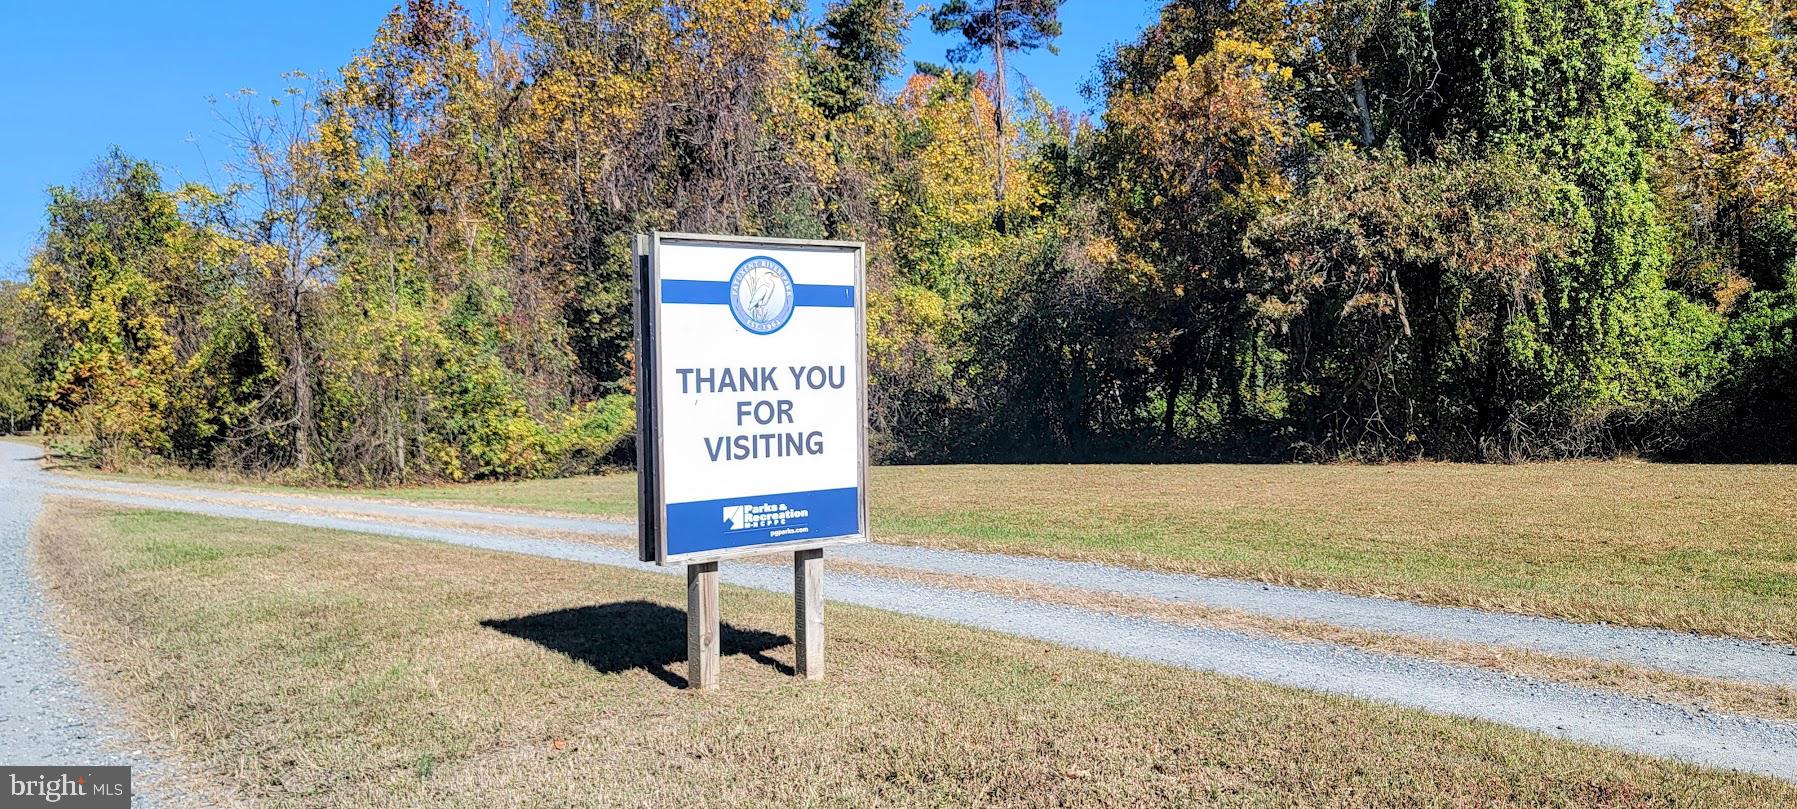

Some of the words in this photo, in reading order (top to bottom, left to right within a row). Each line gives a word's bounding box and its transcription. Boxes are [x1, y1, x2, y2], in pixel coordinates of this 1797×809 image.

[675, 366, 779, 394] THANK
[788, 365, 846, 390] YOU
[736, 399, 794, 426] FOR
[703, 430, 824, 462] VISITING
[744, 503, 778, 514] Parks
[778, 503, 788, 511] &
[744, 509, 809, 523] Recreation
[769, 526, 809, 538] pgparks.com
